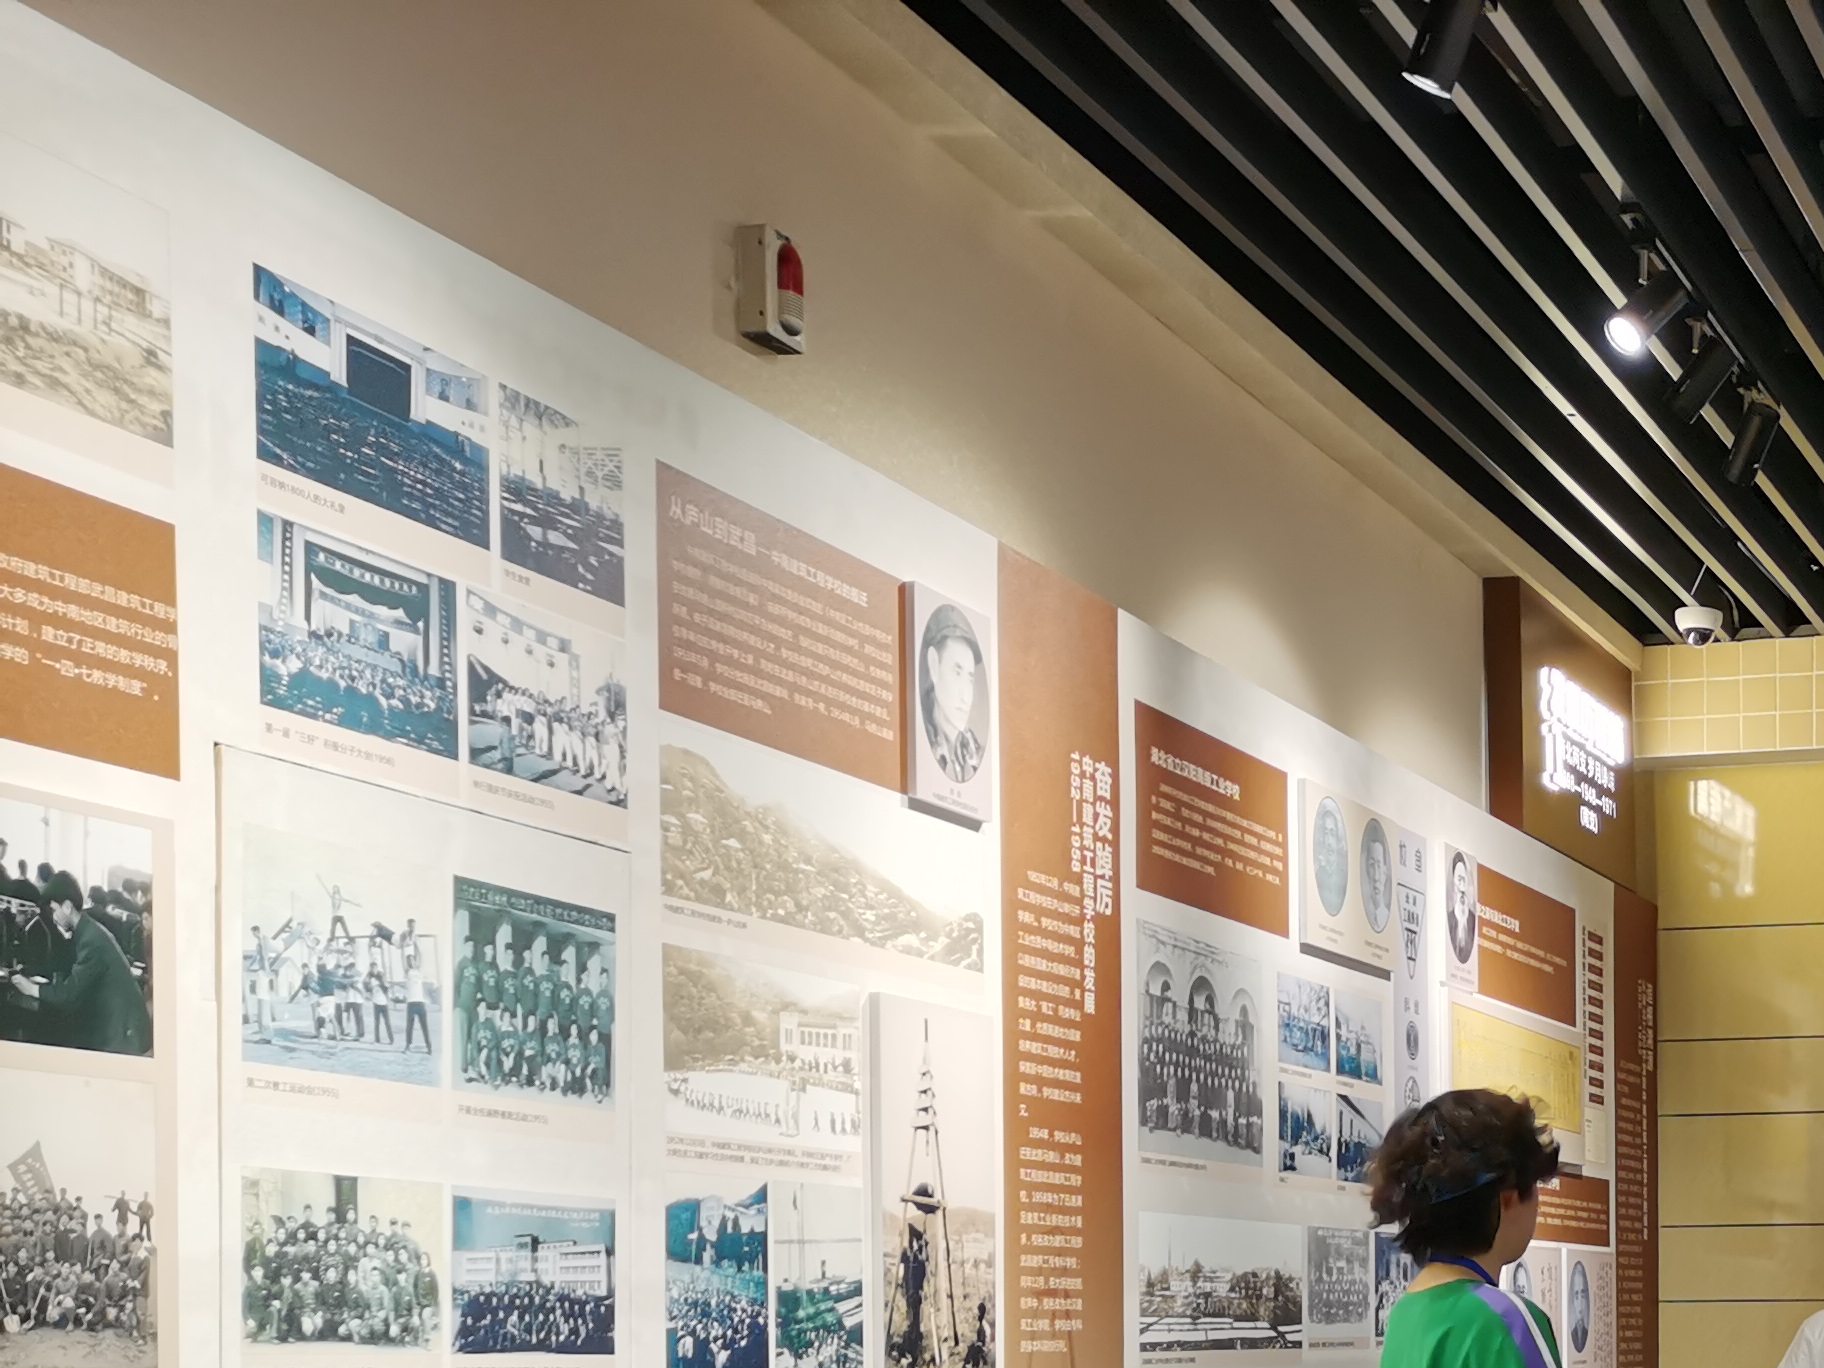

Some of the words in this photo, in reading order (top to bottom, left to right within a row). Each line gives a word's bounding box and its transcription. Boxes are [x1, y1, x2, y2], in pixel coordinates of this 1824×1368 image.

[1082, 754, 1096, 1015] 中南建筑工程学校的发展
[1095, 760, 1113, 916] 奋发踔厉
